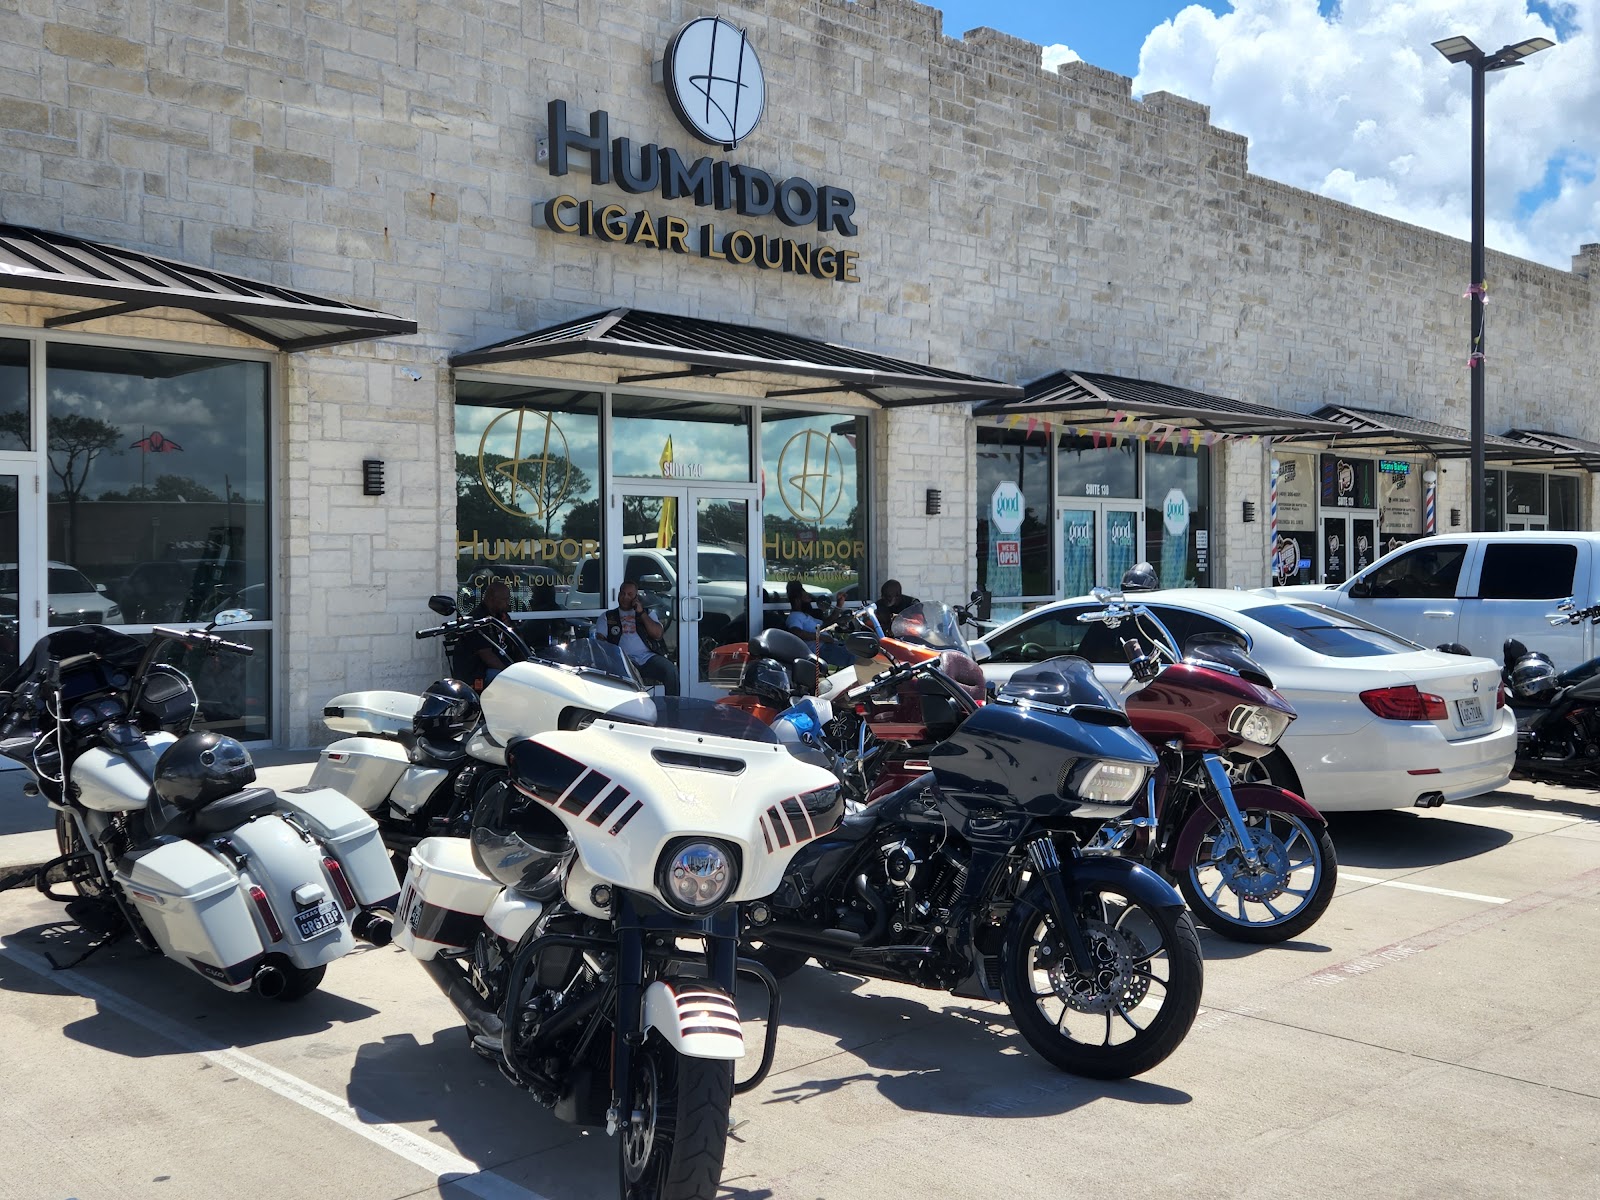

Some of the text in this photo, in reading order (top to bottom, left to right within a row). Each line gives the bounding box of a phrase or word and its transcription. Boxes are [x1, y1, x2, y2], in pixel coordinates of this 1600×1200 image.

[548, 99, 858, 236] HUMIDOR
[545, 195, 861, 283] CIGAR LOUNGE
[1086, 483, 1100, 495] SUITE
[997, 492, 1019, 517] good
[1167, 498, 1184, 520] good
[1069, 521, 1089, 544] good
[1112, 521, 1130, 544] good
[456, 530, 600, 560] HUMIDOR
[762, 532, 865, 559] HUMIDOR
[1000, 552, 1018, 564] OPEN
[528, 575, 584, 587] LOUNGE
[457, 586, 533, 616] CIR
[299, 910, 318, 921] TEXAS
